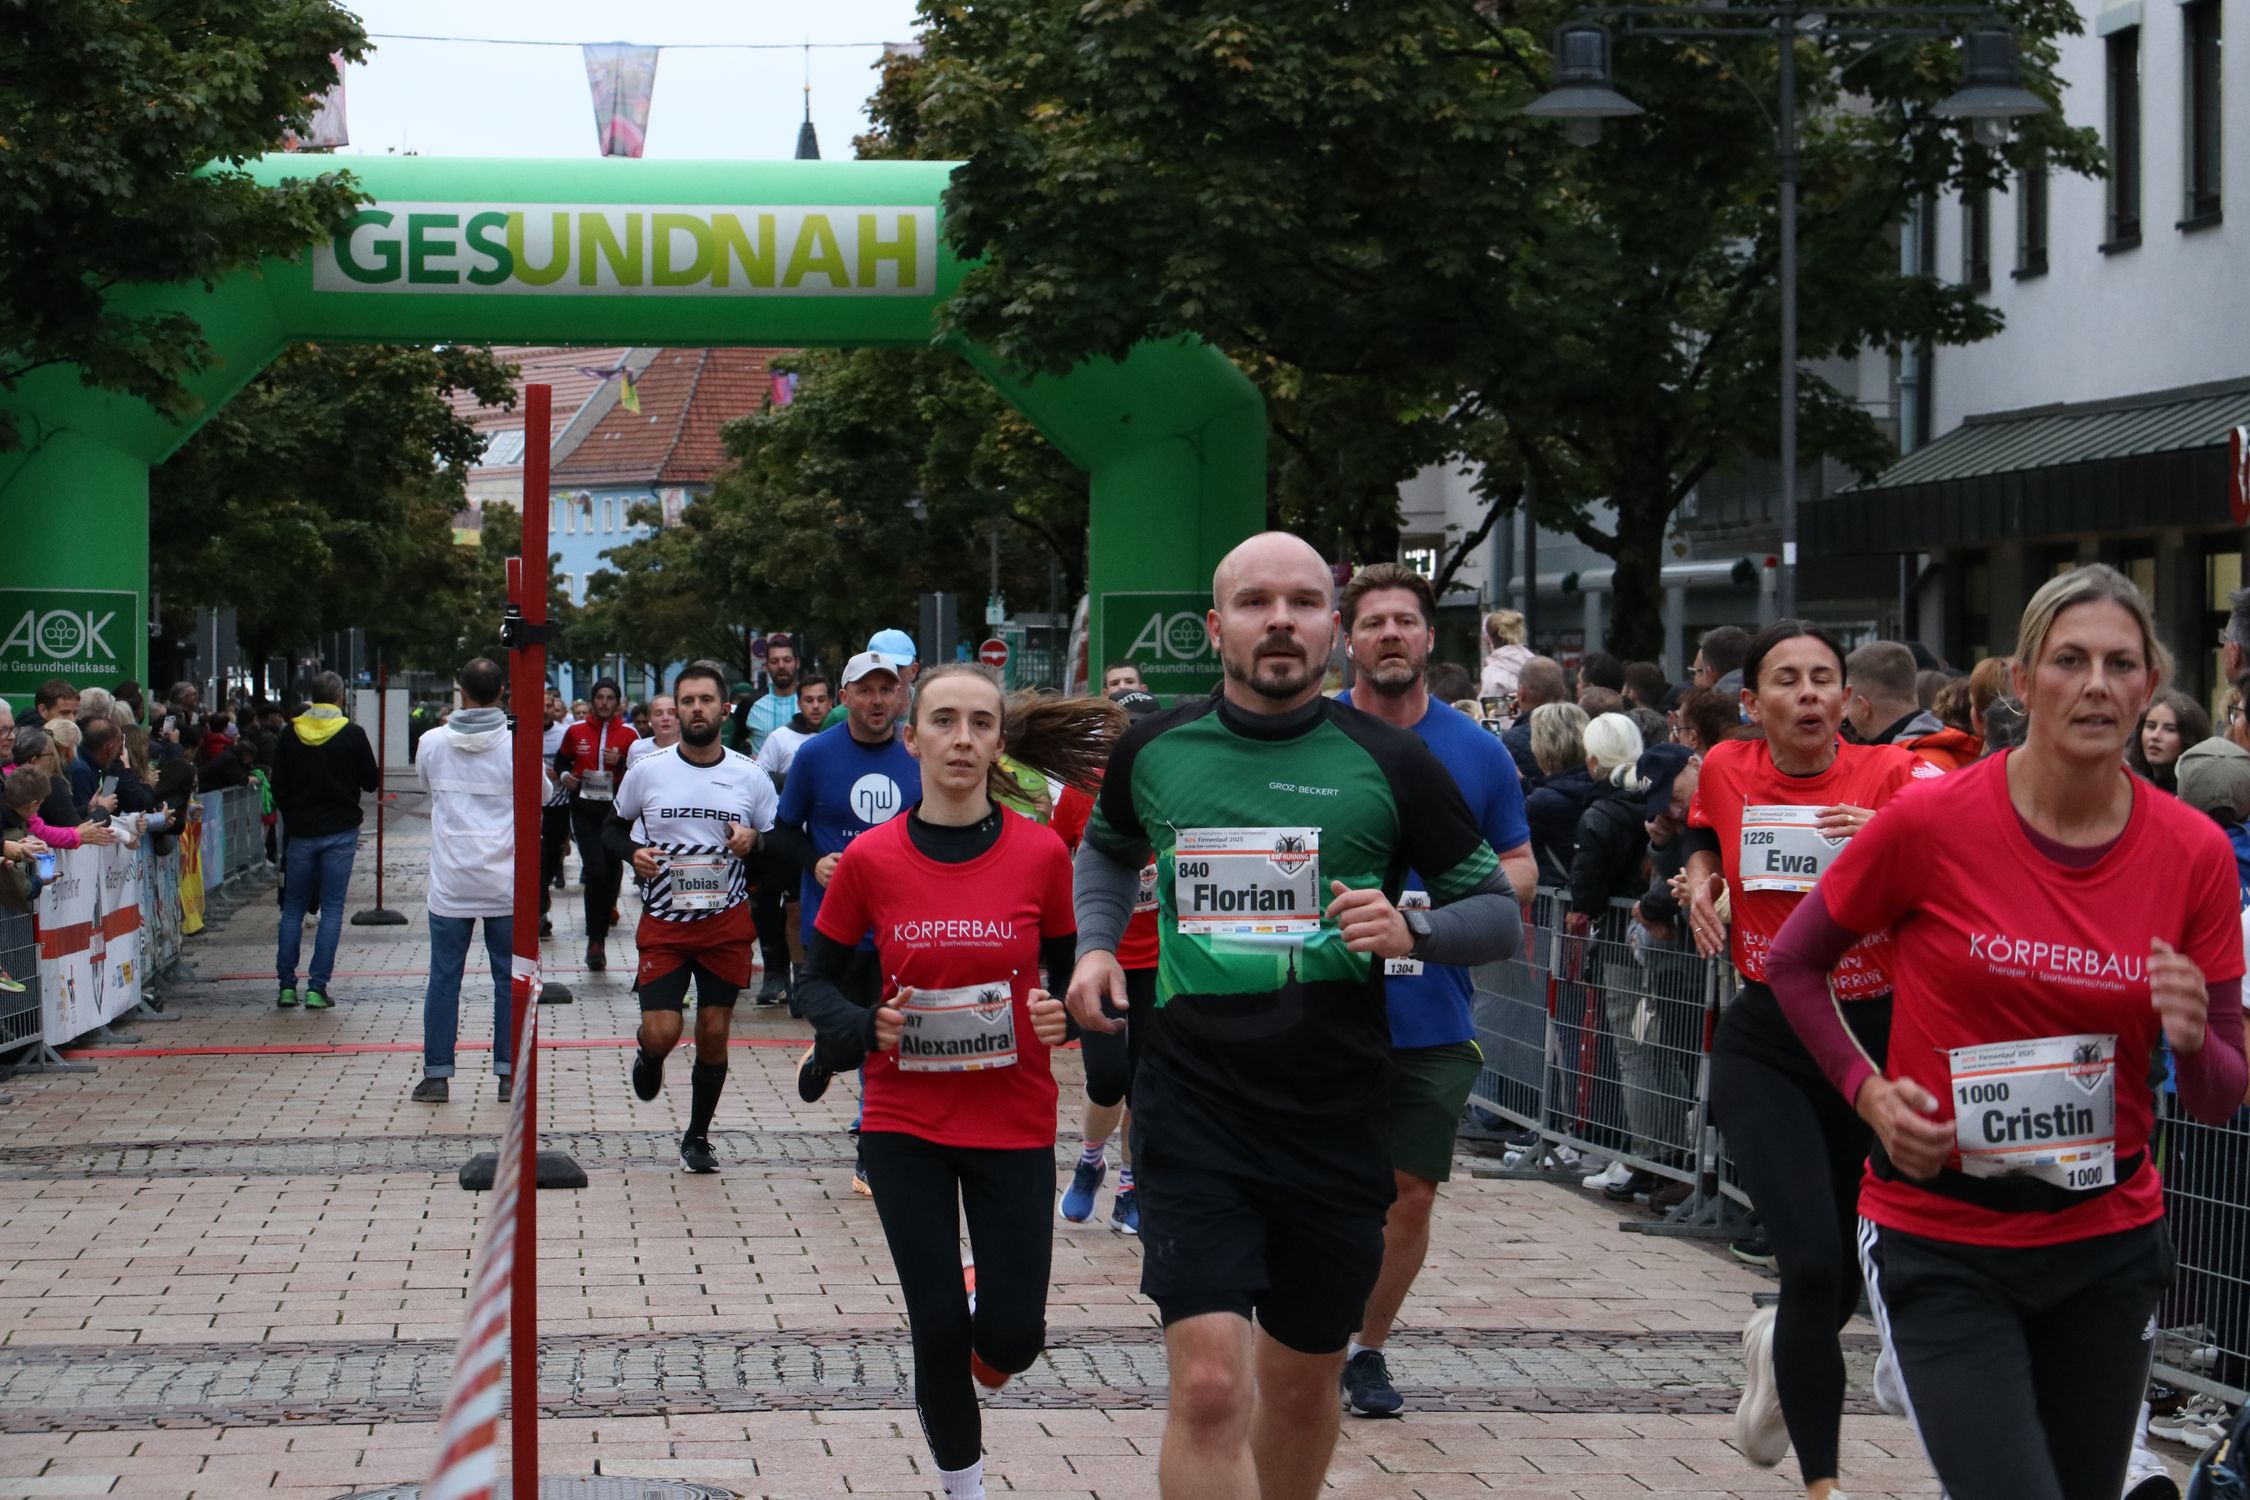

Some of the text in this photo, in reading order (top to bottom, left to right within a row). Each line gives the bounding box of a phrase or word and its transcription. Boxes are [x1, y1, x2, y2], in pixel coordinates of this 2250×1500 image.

[333, 209, 917, 288] GESUNDNAH
[0, 609, 117, 659] AOK
[1124, 611, 1218, 660] AO
[11, 661, 120, 674] Gesundheitskasse.
[1743, 831, 1775, 846] 1226
[670, 869, 684, 877] 510
[1179, 862, 1210, 878] 840
[1766, 849, 1818, 875] Ewa
[677, 878, 719, 891] Tobias
[1194, 883, 1296, 912] Florian
[894, 920, 1017, 942] KÖRPERBAU.
[1391, 963, 1415, 974] 1304
[1969, 932, 2149, 984] KÖRPERBAU.
[2038, 970, 2127, 992] Sportwissenschaften
[904, 1015, 923, 1028] 97
[901, 1033, 1010, 1056] Alexandra
[1957, 1082, 2010, 1105] 1000
[1982, 1103, 2094, 1144] Cristin
[2067, 1166, 2103, 1187] 1000
